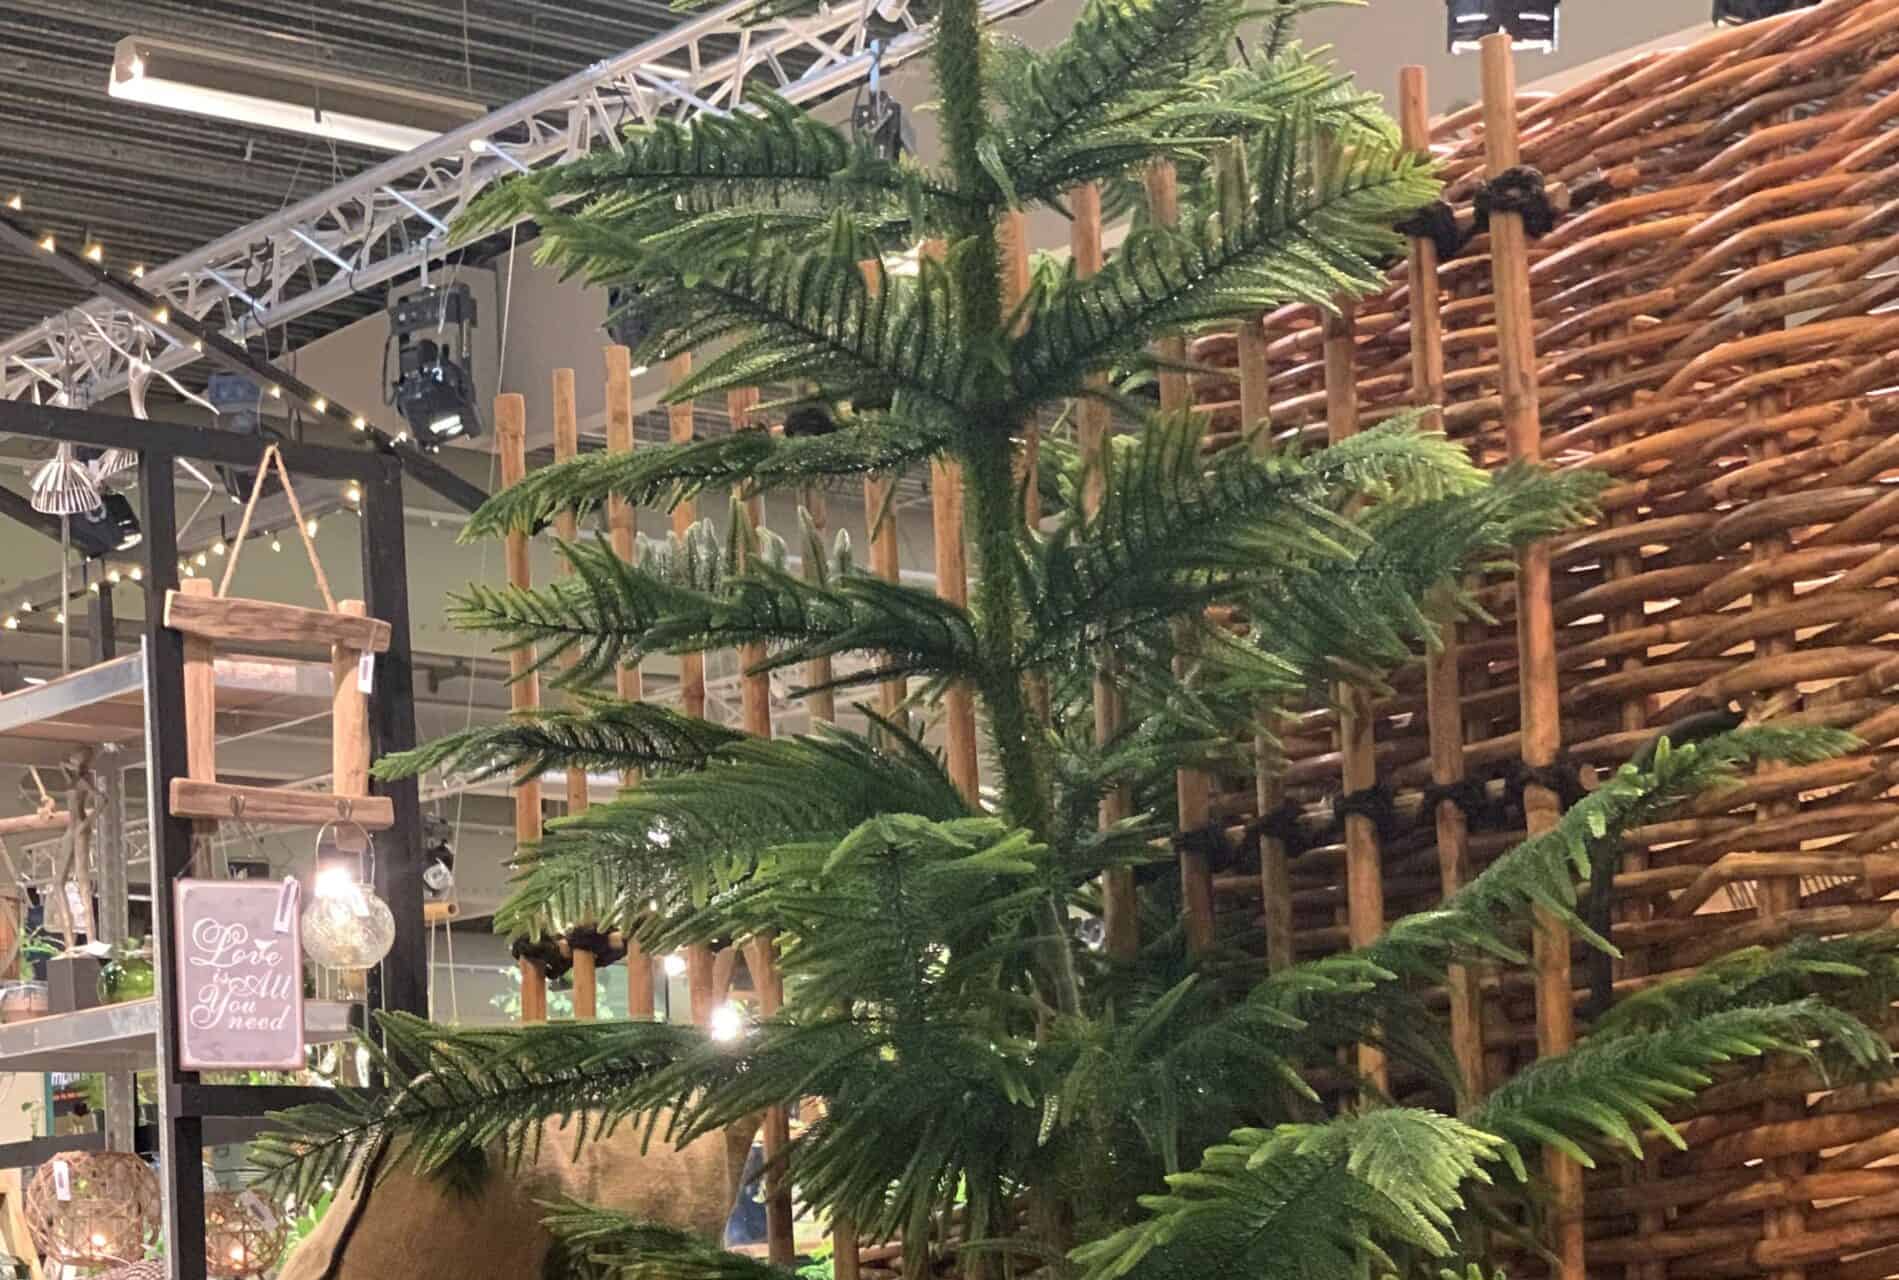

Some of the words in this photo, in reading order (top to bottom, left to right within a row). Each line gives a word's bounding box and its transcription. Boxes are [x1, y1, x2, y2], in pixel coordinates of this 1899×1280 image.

[189, 917, 284, 968] Love
[212, 968, 229, 986] is
[228, 969, 292, 1000] All
[189, 983, 257, 1030] You
[228, 1004, 292, 1031] need
